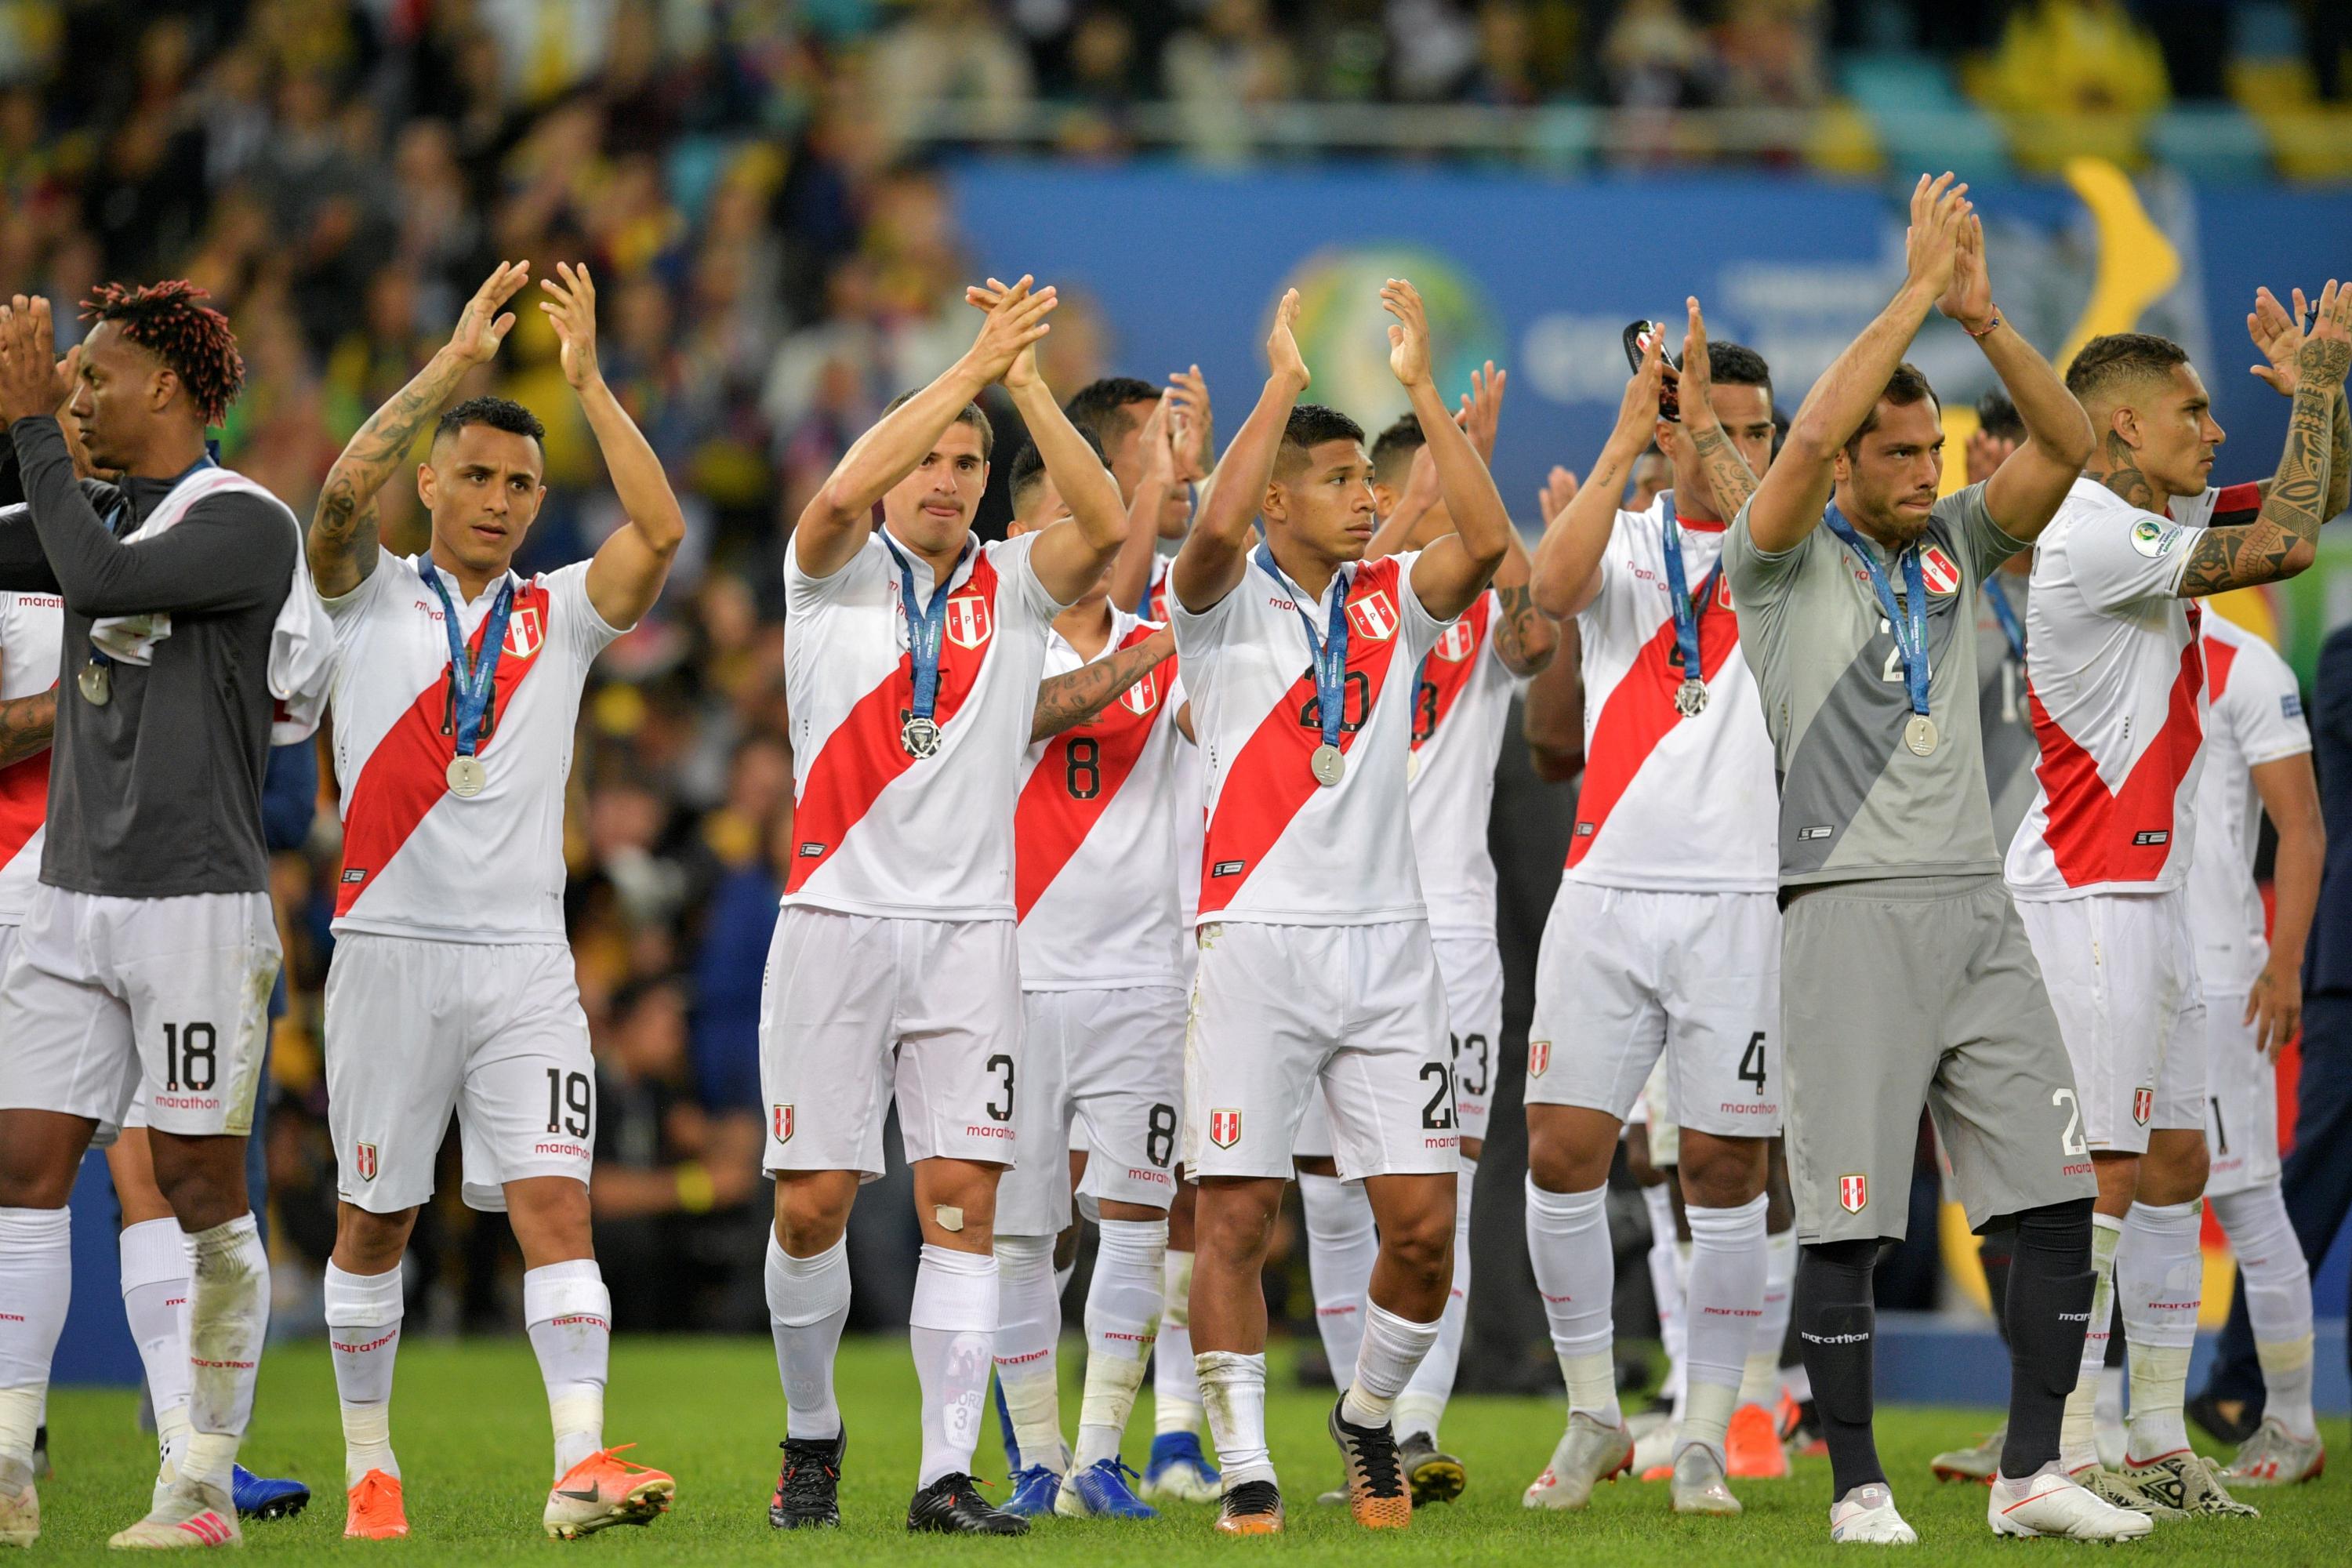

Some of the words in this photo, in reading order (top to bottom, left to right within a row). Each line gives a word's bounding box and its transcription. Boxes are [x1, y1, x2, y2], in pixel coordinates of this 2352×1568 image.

[1922, 561, 1947, 583] FPF
[953, 614, 982, 626] FPF
[1359, 607, 1387, 626] FPF
[1065, 737, 1101, 800] 8
[163, 1022, 216, 1091] 18
[1738, 1031, 1766, 1095] 4
[986, 1054, 1014, 1121] 3
[156, 1095, 220, 1109] marathon
[546, 1068, 591, 1139] 19
[1721, 1102, 1777, 1115] marathon
[967, 1126, 1015, 1141] maratho
[2053, 1088, 2087, 1156] 2
[1147, 1103, 1176, 1168] 8
[332, 1329, 397, 1354] marathon
[1801, 1330, 1869, 1344] marathon
[954, 1407, 968, 1431] 3
